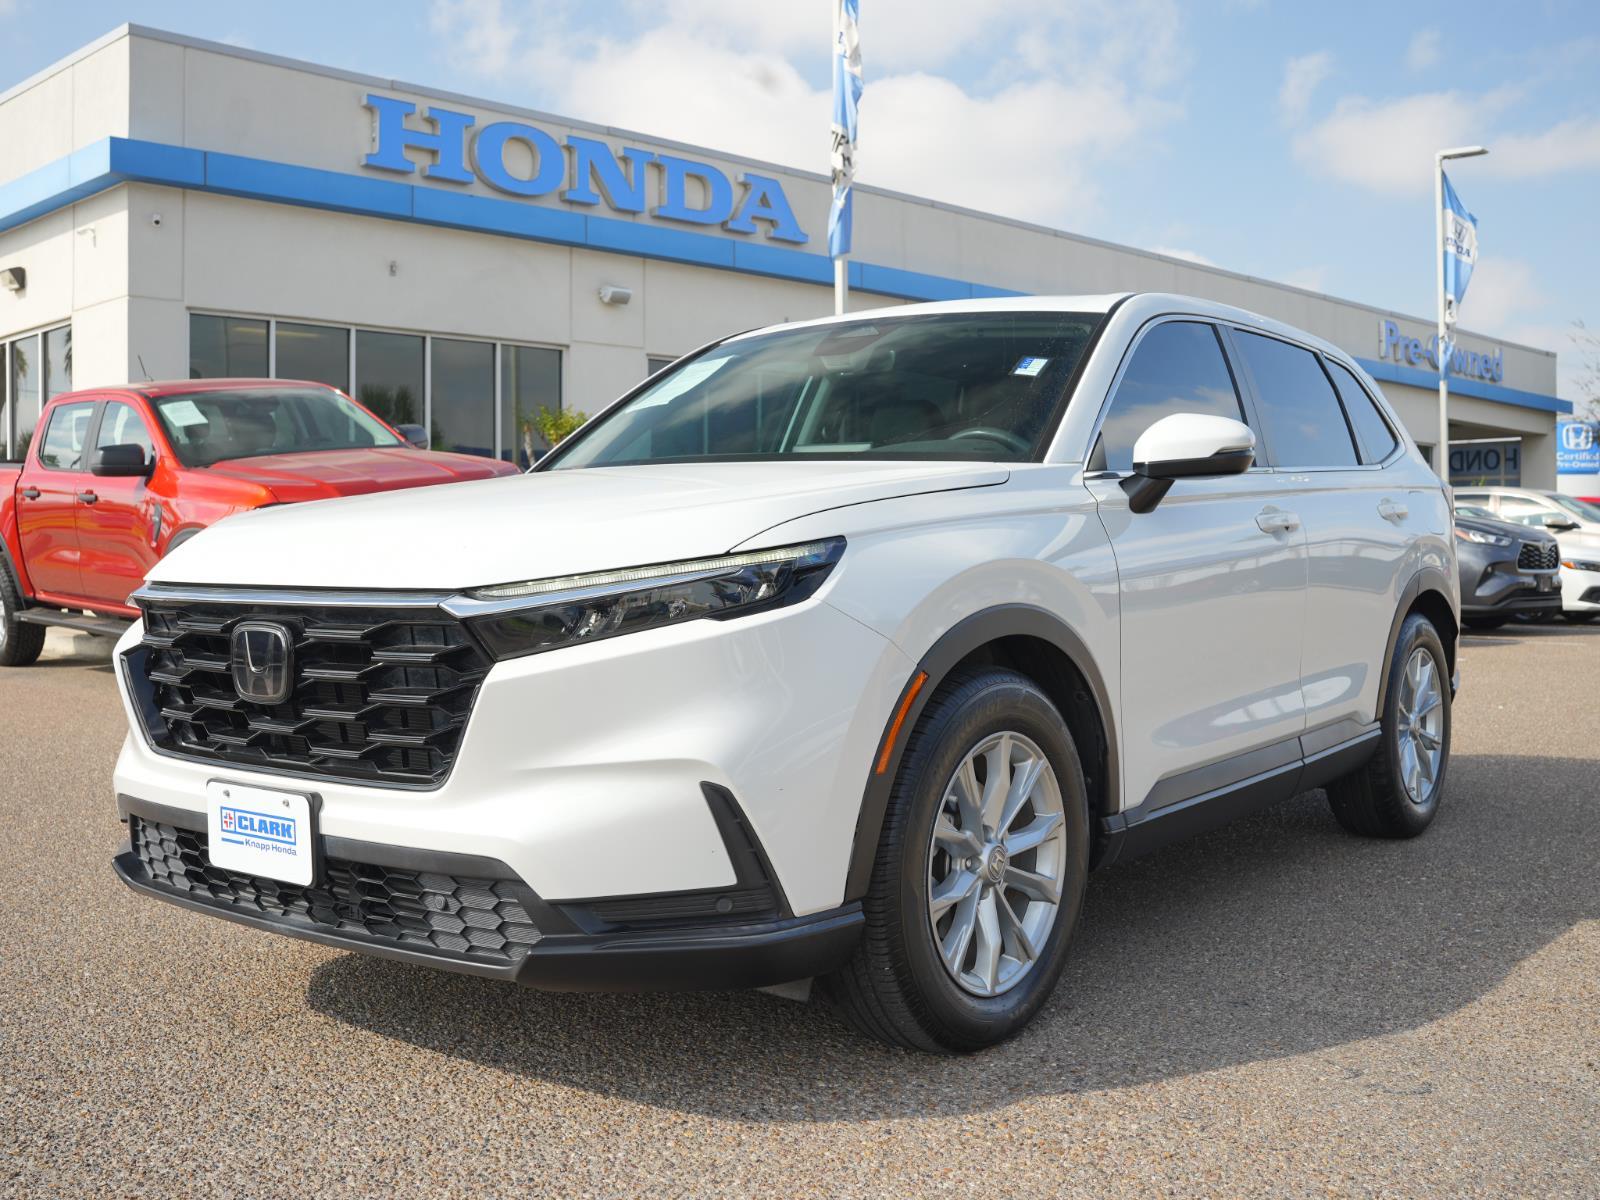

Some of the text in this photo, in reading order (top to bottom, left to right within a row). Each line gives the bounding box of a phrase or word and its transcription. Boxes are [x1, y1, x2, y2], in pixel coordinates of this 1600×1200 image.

[361, 93, 809, 244] HONDA
[237, 815, 293, 838] CLARK
[245, 838, 297, 856] Knapp Honda
